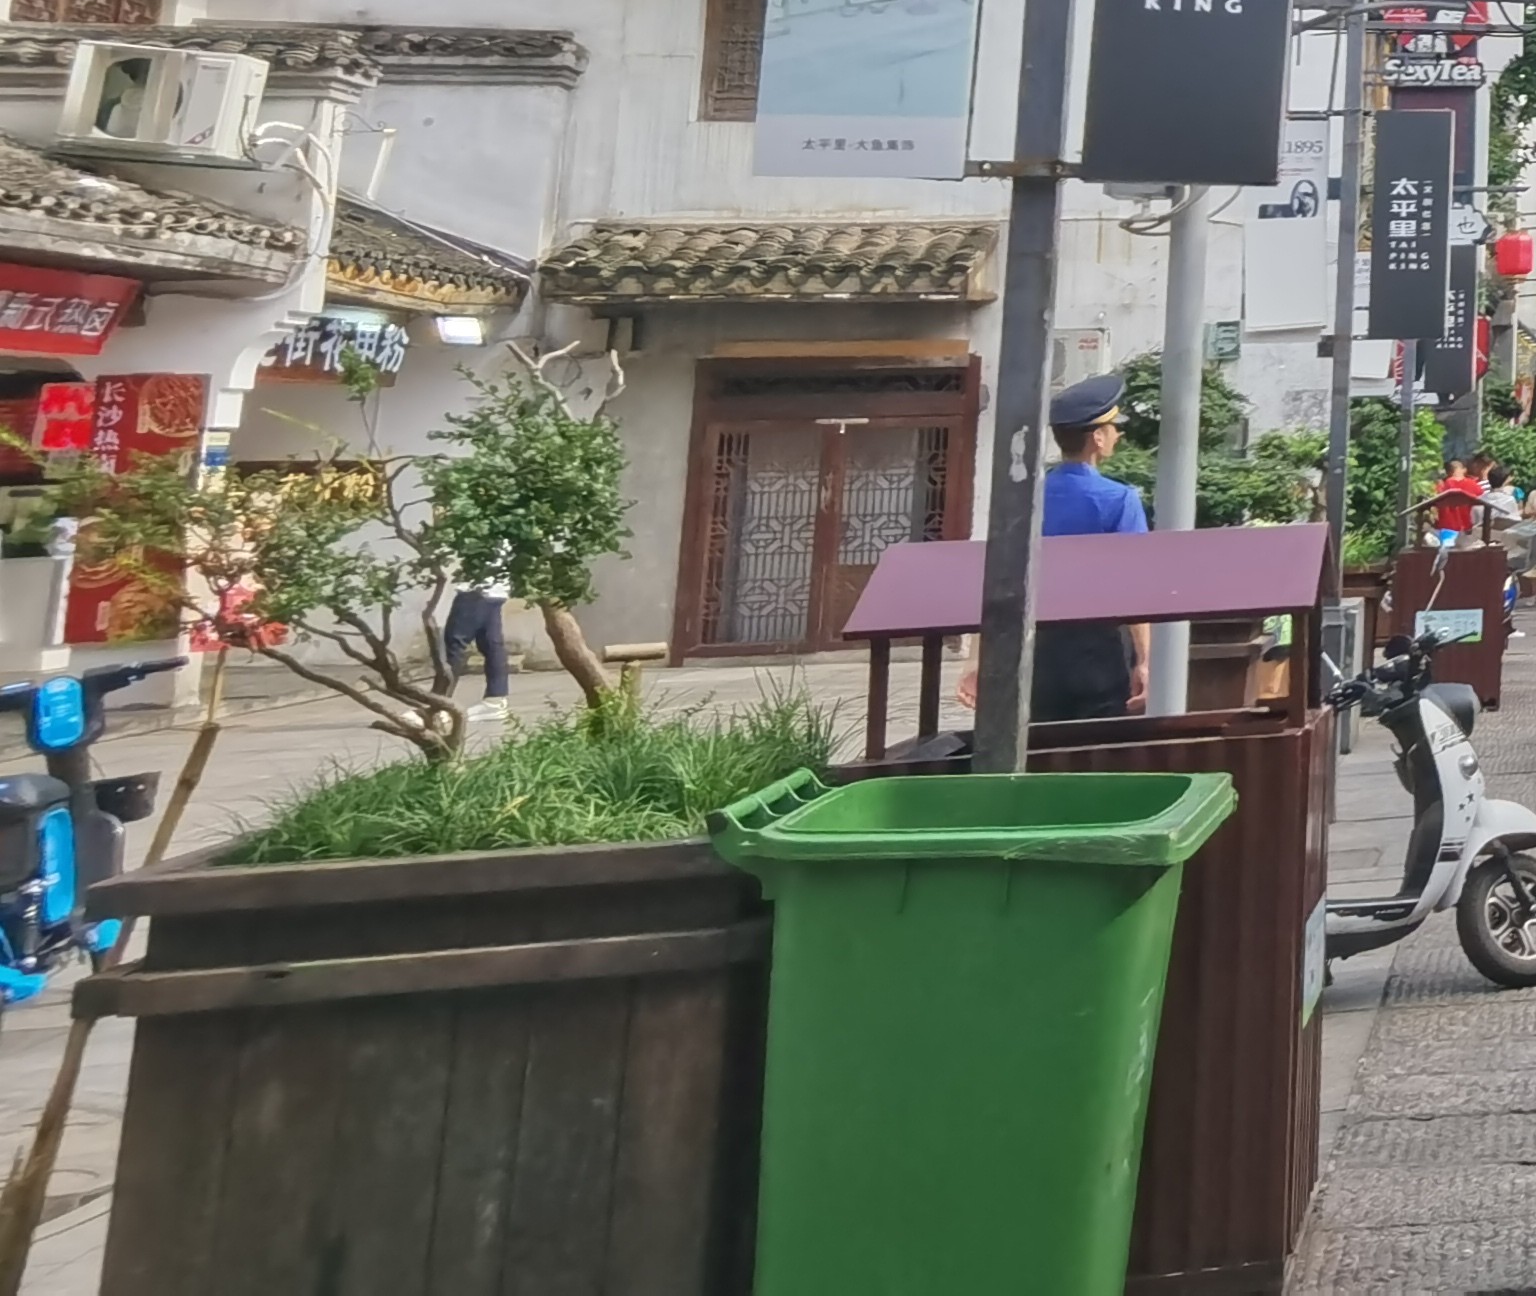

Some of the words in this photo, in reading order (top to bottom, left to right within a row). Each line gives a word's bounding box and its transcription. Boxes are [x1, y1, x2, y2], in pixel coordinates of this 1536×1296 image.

[1382, 58, 1482, 85] SexyTea
[1285, 140, 1324, 154] 1895
[1388, 177, 1419, 237] 太平里
